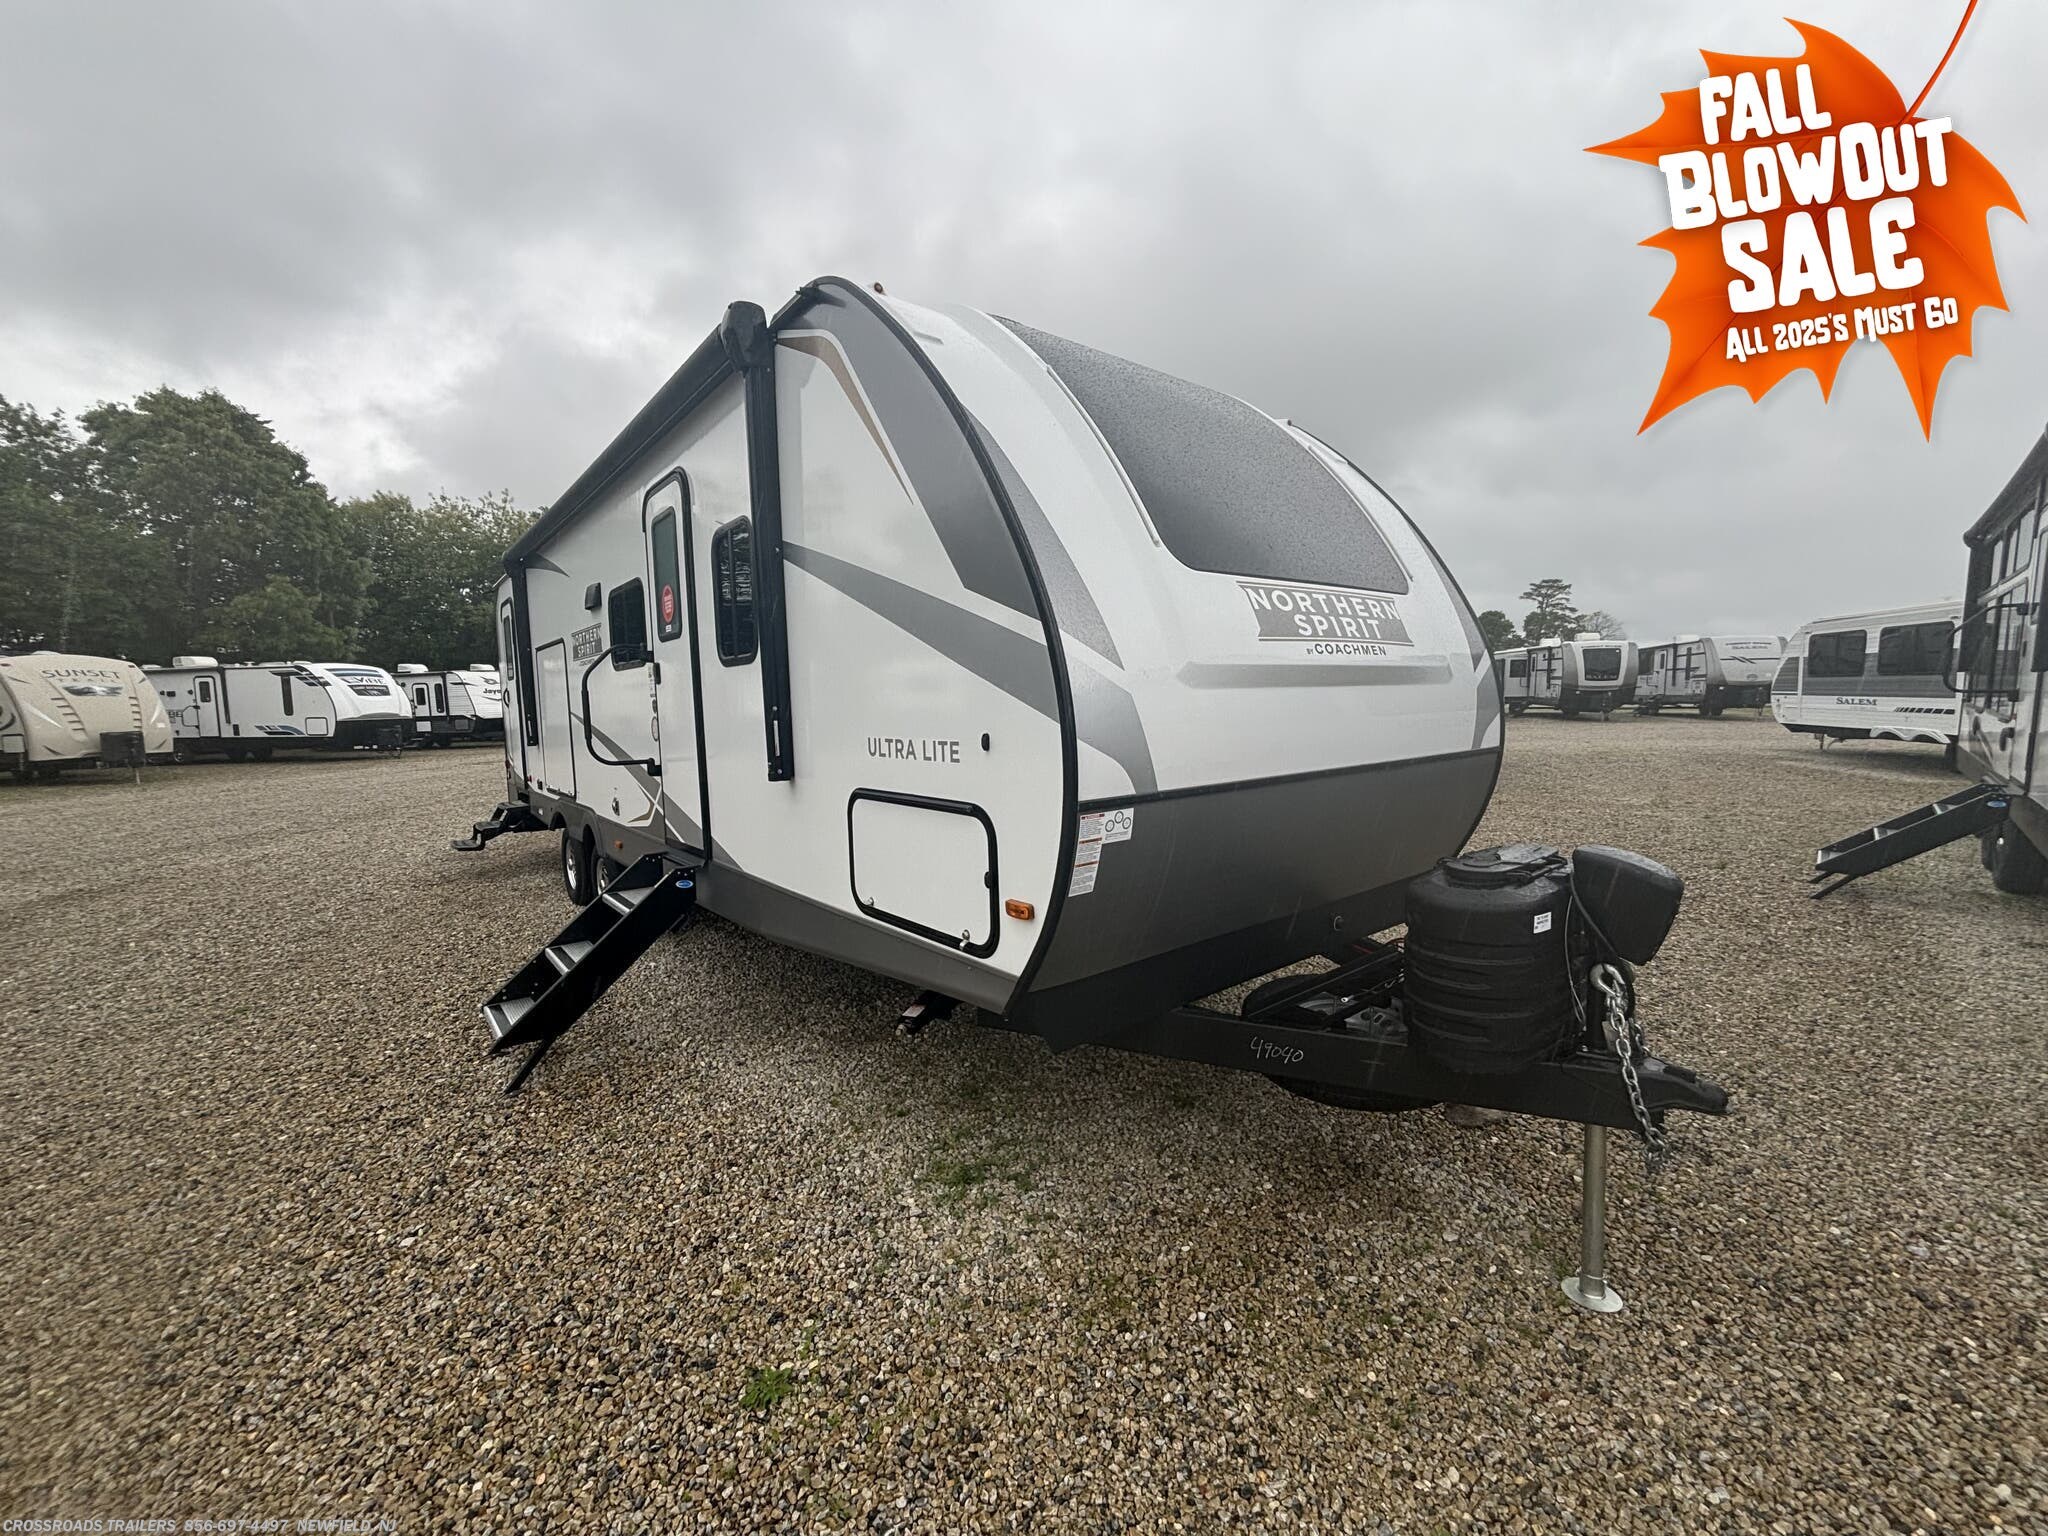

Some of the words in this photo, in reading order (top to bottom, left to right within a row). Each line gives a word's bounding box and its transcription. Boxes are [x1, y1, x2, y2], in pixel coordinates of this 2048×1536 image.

[1245, 587, 1401, 620] NORTHERN
[1294, 613, 1382, 640] SPIRIT
[1314, 643, 1387, 656] COACHMEN
[41, 669, 121, 680] SUNSET
[1836, 696, 1878, 706] SALEM
[867, 737, 917, 761] ULTRA
[922, 740, 961, 763] LITE
[1250, 1036, 1304, 1064] 49040
